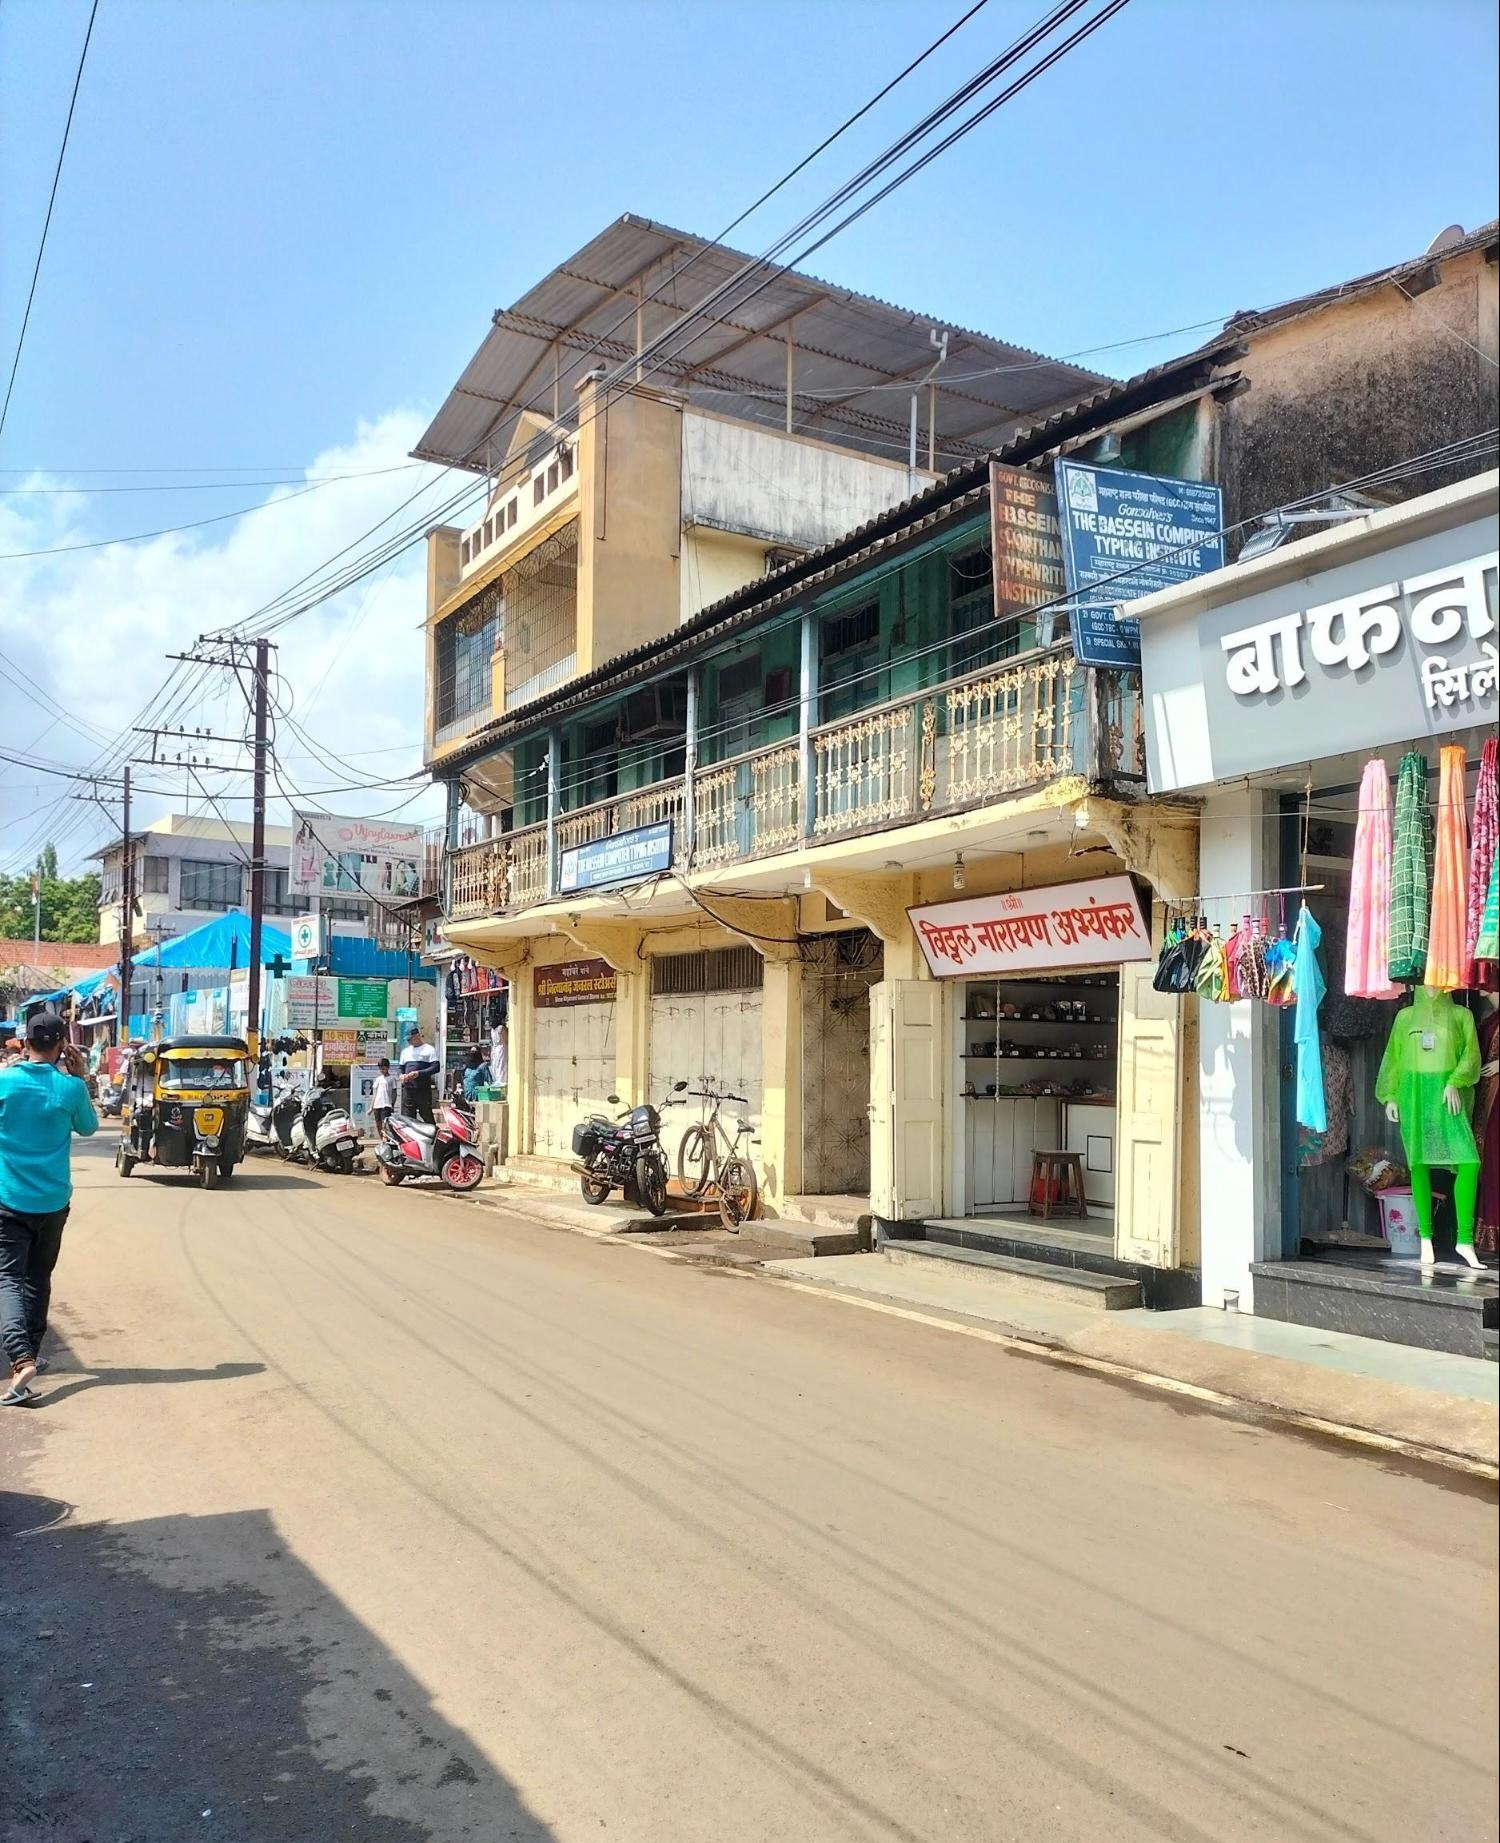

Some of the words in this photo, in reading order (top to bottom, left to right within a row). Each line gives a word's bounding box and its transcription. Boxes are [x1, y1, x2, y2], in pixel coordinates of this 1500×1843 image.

[1072, 510, 1097, 533] THE
[1097, 515, 1156, 541] BASSEIN
[1156, 523, 1219, 549] COMPUTER
[1094, 534, 1144, 559] TYPING
[1145, 541, 1201, 568] INSTITUTE
[972, 914, 1052, 953] नारायण
[1051, 896, 1141, 946] अभ्यंकर
